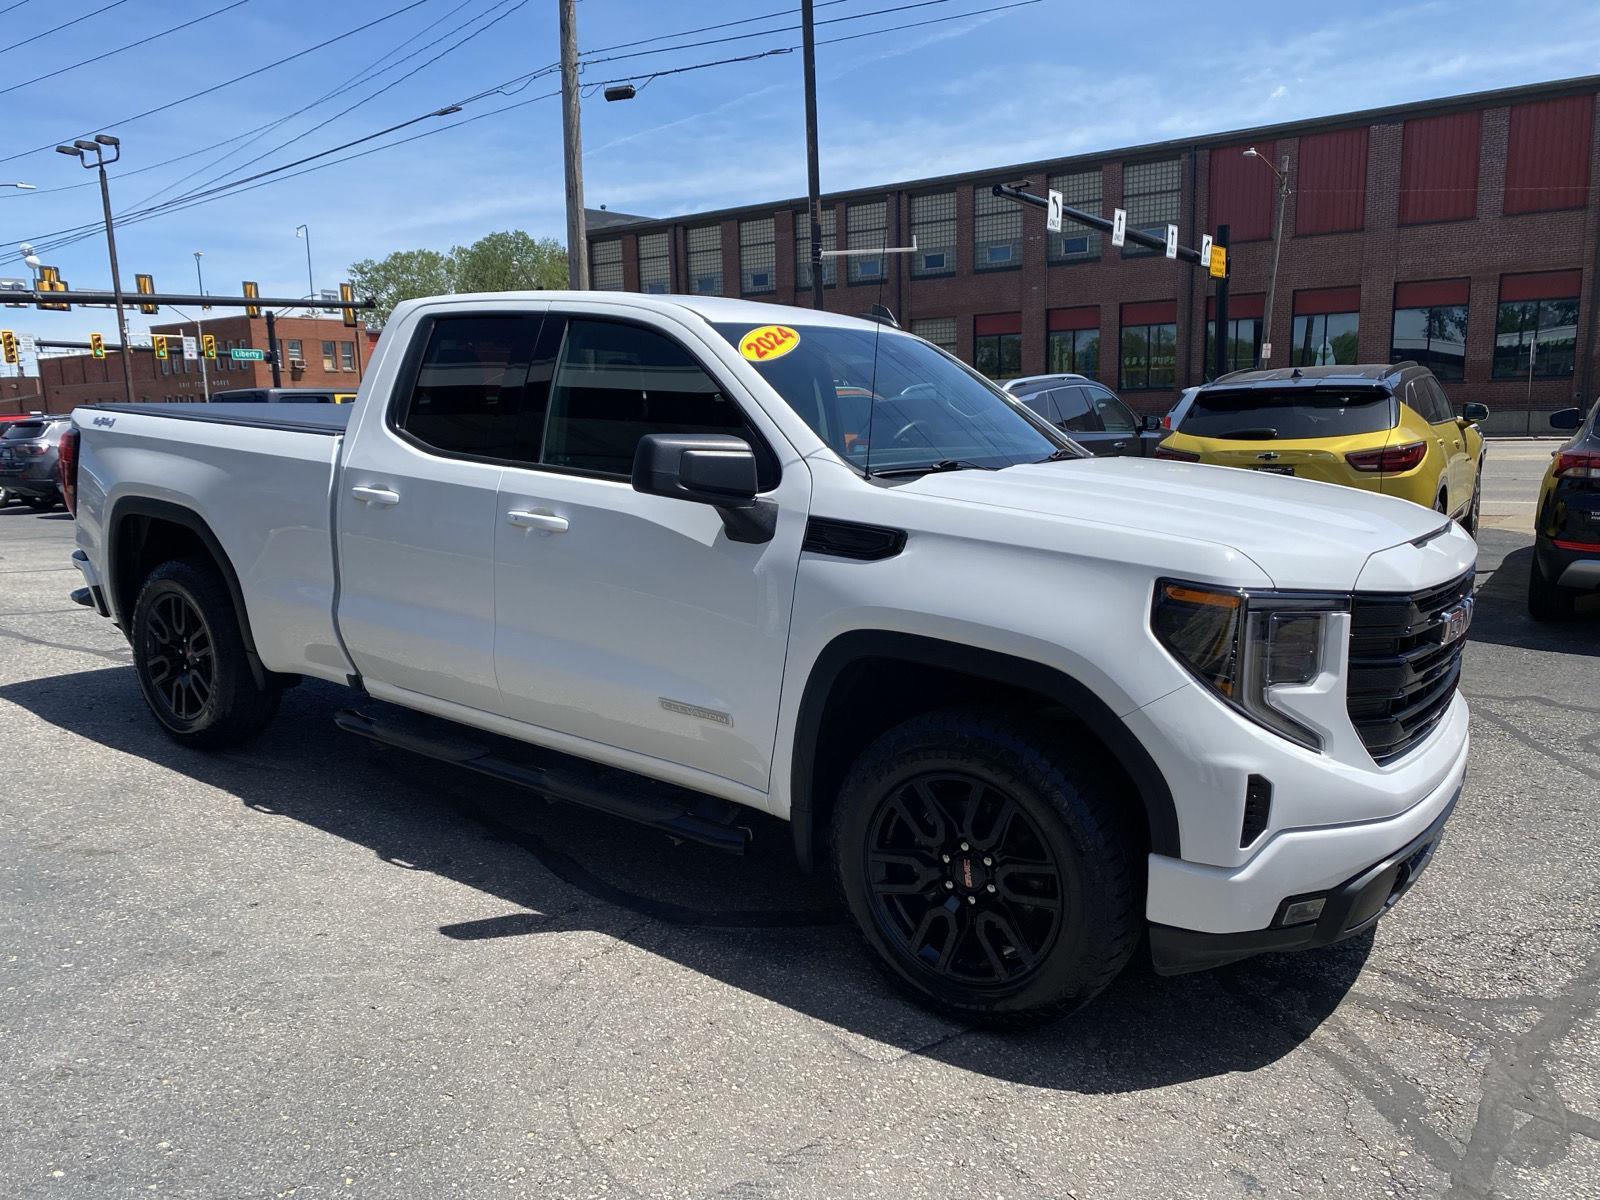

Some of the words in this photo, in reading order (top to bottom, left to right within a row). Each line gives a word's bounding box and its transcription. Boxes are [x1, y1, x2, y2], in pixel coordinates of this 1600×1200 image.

[235, 350, 260, 359] Liberty
[746, 327, 795, 359] 2024
[963, 858, 973, 888] GMC
